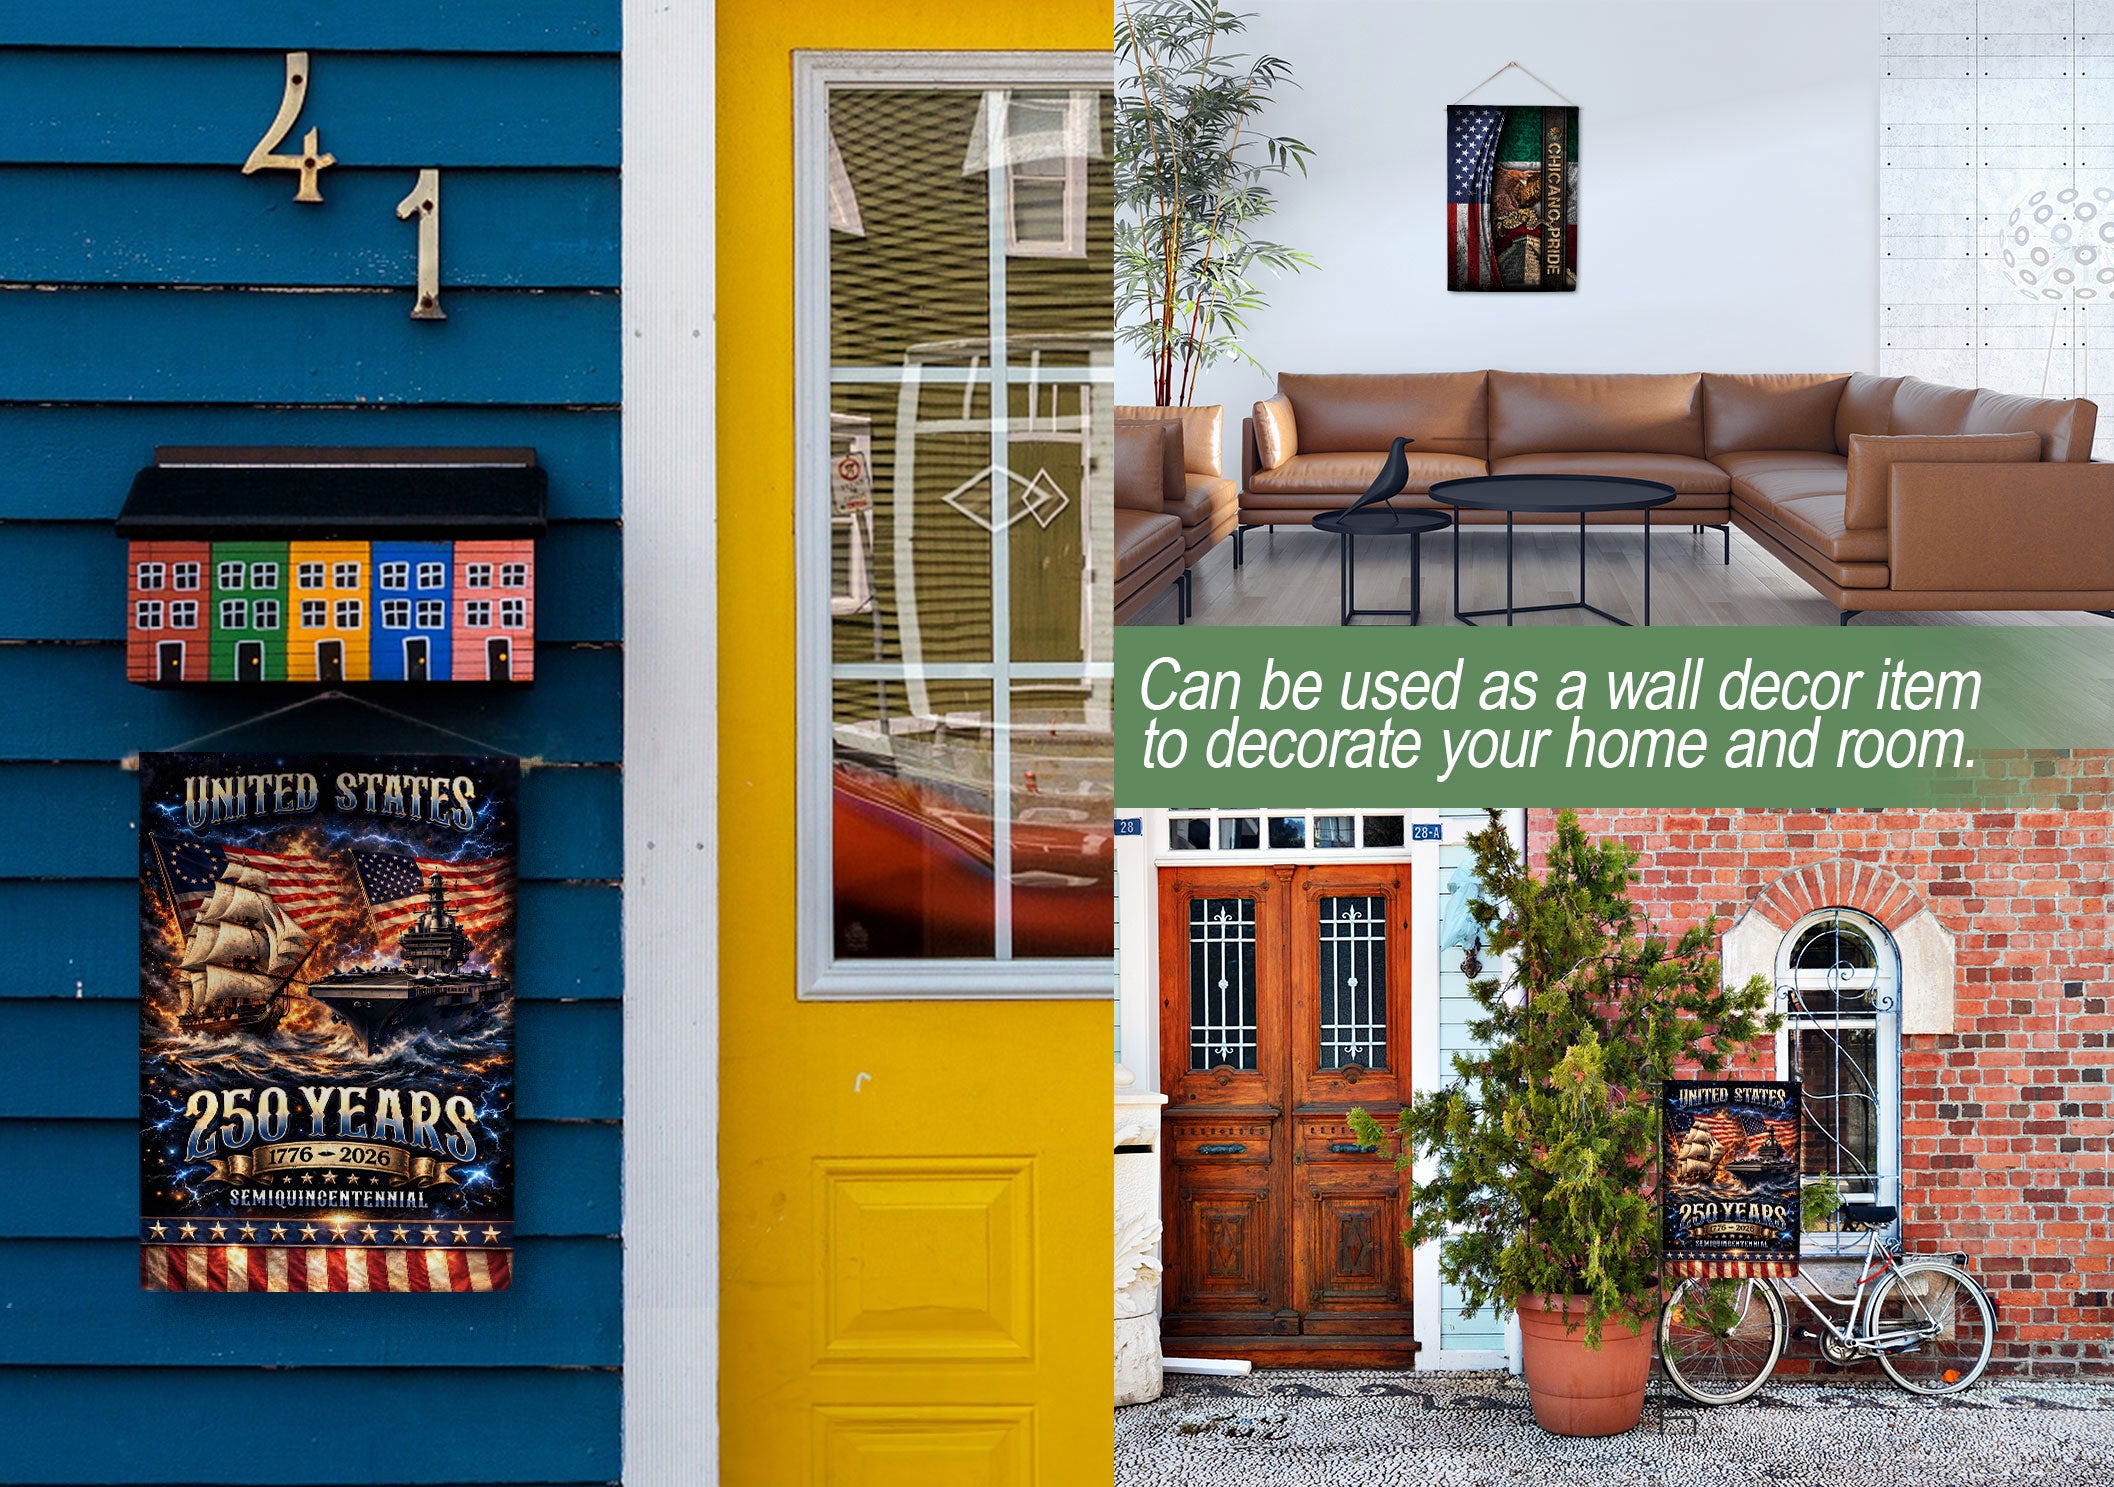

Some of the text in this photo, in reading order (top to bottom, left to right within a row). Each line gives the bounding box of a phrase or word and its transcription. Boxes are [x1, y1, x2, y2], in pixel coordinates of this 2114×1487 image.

[1546, 143, 1562, 275] CHICANO PRIDE
[183, 772, 476, 832] UNITED STATES
[1120, 821, 1134, 833] 28
[1414, 826, 1440, 839] 28-A
[1678, 1087, 1787, 1110] UNITED STATES
[184, 1085, 479, 1163] 250 YEARS
[268, 1146, 313, 1165] 1776
[339, 1147, 391, 1166] 2026
[229, 1187, 429, 1209] SEMIQUINCENTENNIAL
[1679, 1202, 1787, 1232] 250 YEARS
[1709, 1224, 1727, 1233] 1776
[1735, 1225, 1756, 1233] 2026
